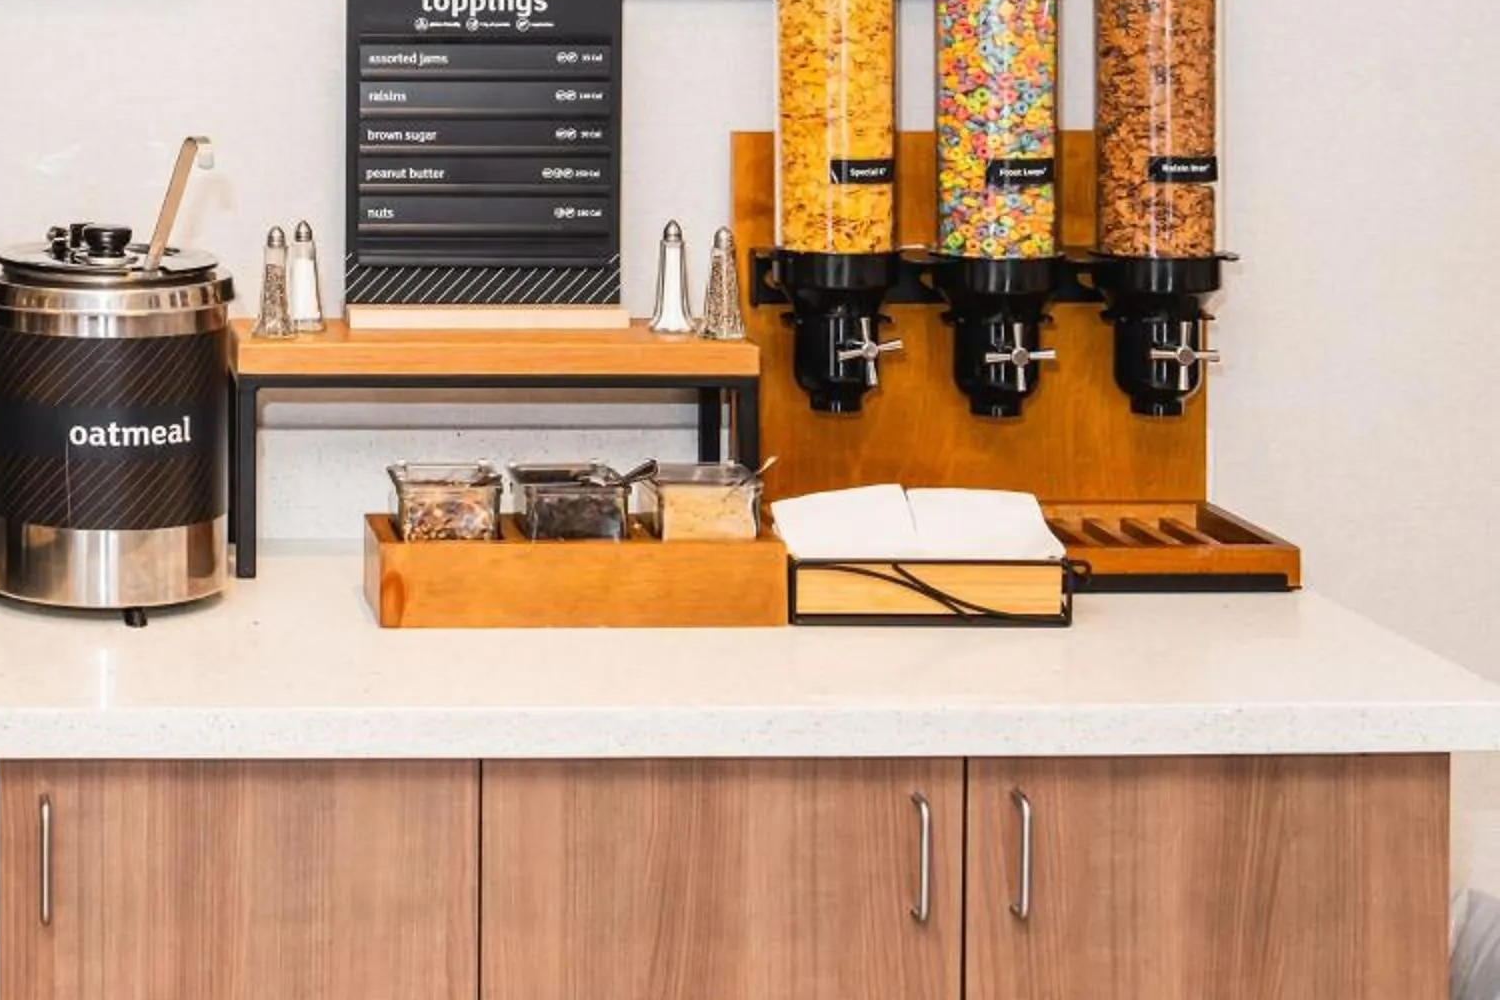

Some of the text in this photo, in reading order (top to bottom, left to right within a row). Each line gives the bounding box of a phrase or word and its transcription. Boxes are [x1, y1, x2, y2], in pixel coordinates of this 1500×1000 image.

[369, 52, 449, 67] assorted jams
[369, 89, 407, 102] raisins
[367, 128, 437, 143] brown sugar
[366, 167, 445, 181] peanut butter
[850, 167, 879, 179] Special
[367, 207, 395, 218] nuts
[69, 415, 192, 447] oatmeal
